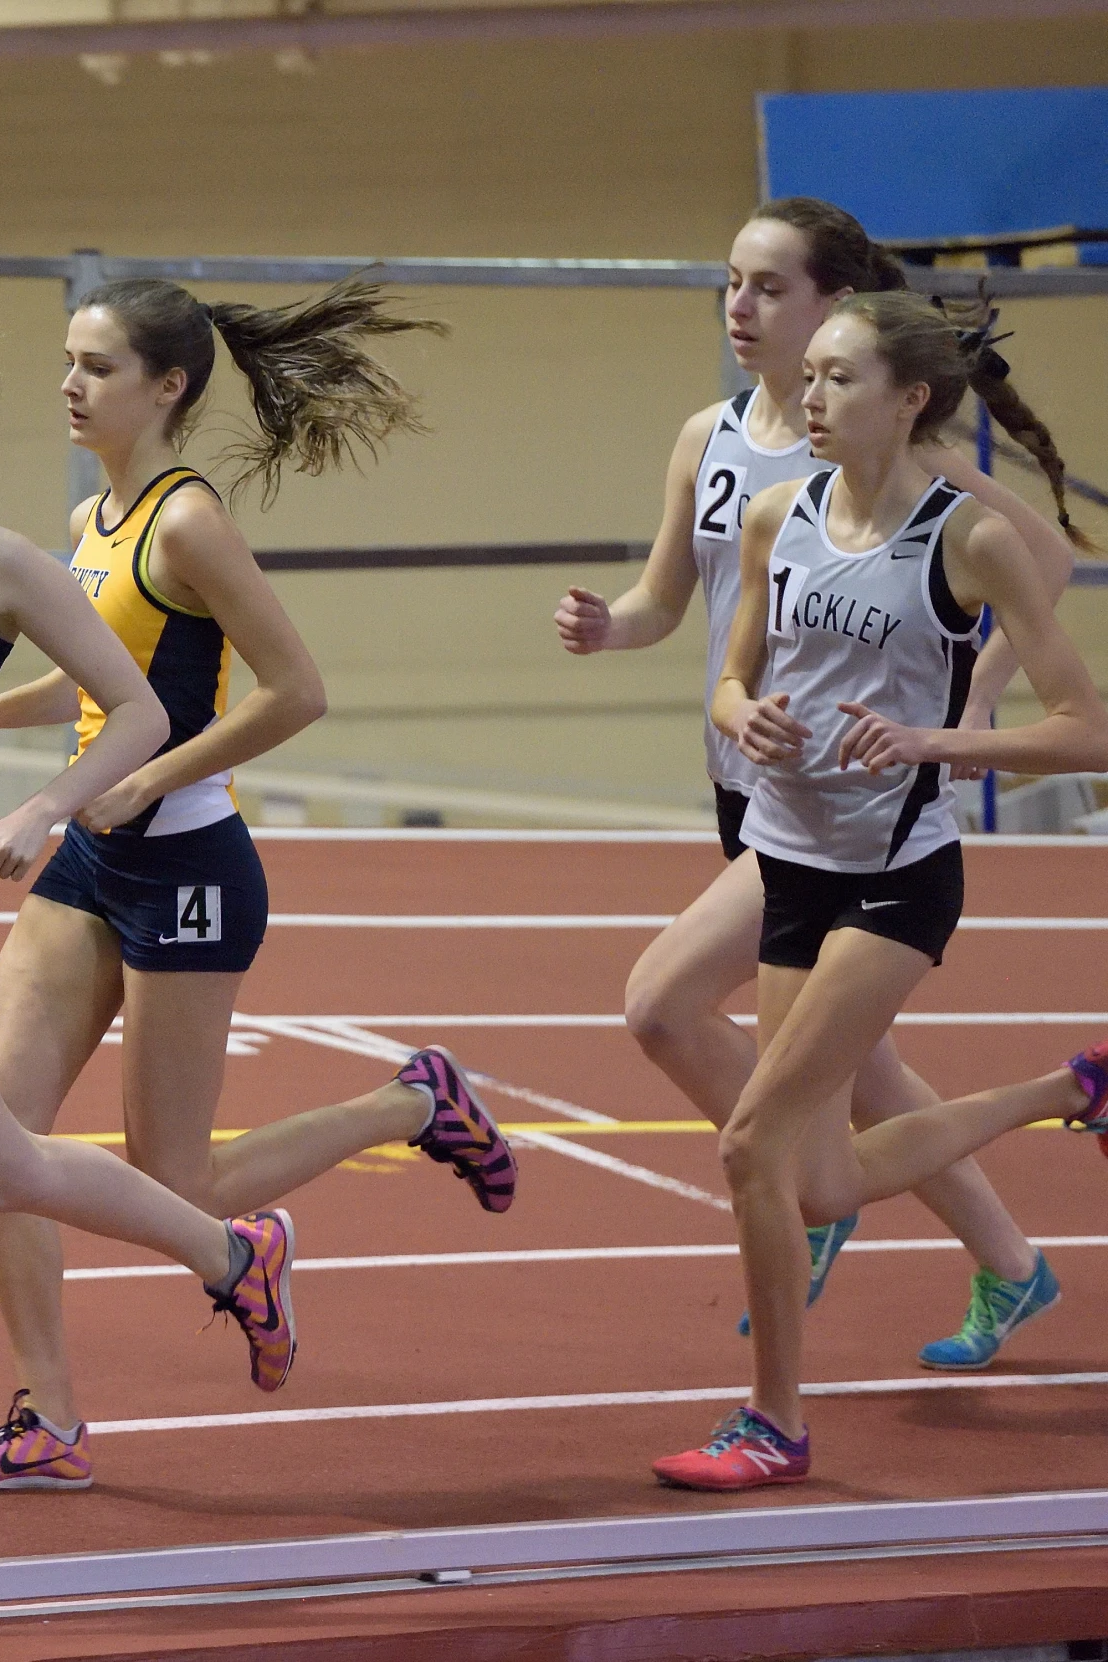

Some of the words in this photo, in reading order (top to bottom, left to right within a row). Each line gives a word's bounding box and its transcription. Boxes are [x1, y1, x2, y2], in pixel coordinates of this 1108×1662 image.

[699, 468, 736, 534] 2
[773, 566, 792, 632] 1
[180, 886, 212, 938] 4
